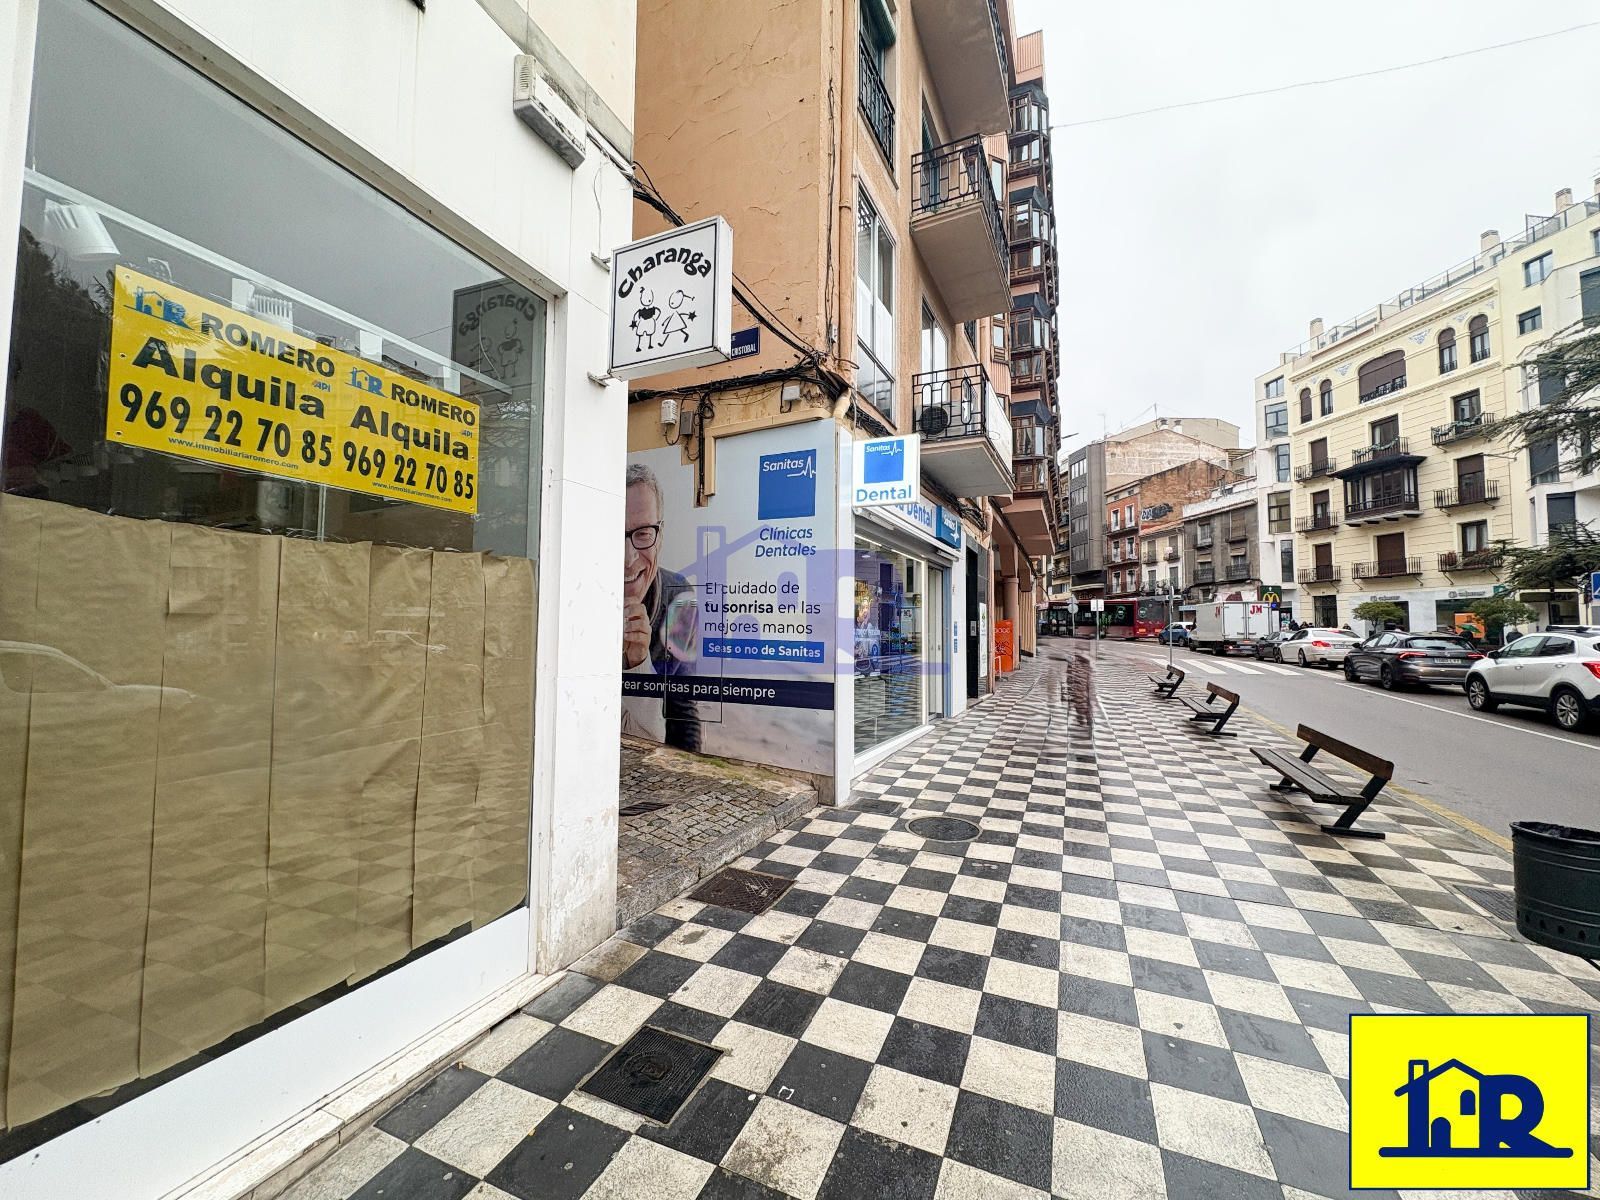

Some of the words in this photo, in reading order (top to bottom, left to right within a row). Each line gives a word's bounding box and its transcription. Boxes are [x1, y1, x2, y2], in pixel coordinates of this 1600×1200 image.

[618, 247, 712, 300] Charanga
[201, 312, 336, 377] ROMERO
[132, 336, 326, 419] Alquila
[391, 383, 476, 426] ROMERO
[120, 383, 191, 434] 969
[203, 405, 243, 447] 22
[257, 417, 291, 457] 70
[301, 430, 332, 467] 85
[350, 405, 469, 460] Alquila
[168, 436, 299, 470] www.inmobiliariaromero.com
[865, 444, 891, 453] Sanitas
[343, 441, 386, 479] 969
[394, 454, 416, 486] 22
[425, 462, 448, 494] 70
[453, 470, 474, 499] 85
[762, 459, 804, 472] Sanitas
[856, 485, 912, 502] Dental
[906, 503, 933, 528] Dental
[760, 526, 813, 541] Clínicas
[755, 542, 816, 558] Dentales
[705, 582, 717, 594] El
[722, 581, 777, 594] cuidado
[781, 581, 800, 593] de
[704, 601, 719, 613] tu
[722, 600, 774, 613] sonrisa
[778, 604, 796, 613] en
[801, 601, 821, 614] las
[1250, 605, 1262, 615] JM
[704, 619, 759, 635] mejores
[763, 623, 813, 635] manos
[708, 643, 732, 654] Seas
[734, 646, 742, 654] o
[744, 646, 758, 655] no
[761, 645, 775, 655] de
[778, 646, 821, 658] Sanitas
[622, 680, 641, 690] ear
[643, 680, 690, 692] sonrisas
[692, 683, 720, 696] para
[722, 683, 776, 700] siempre
